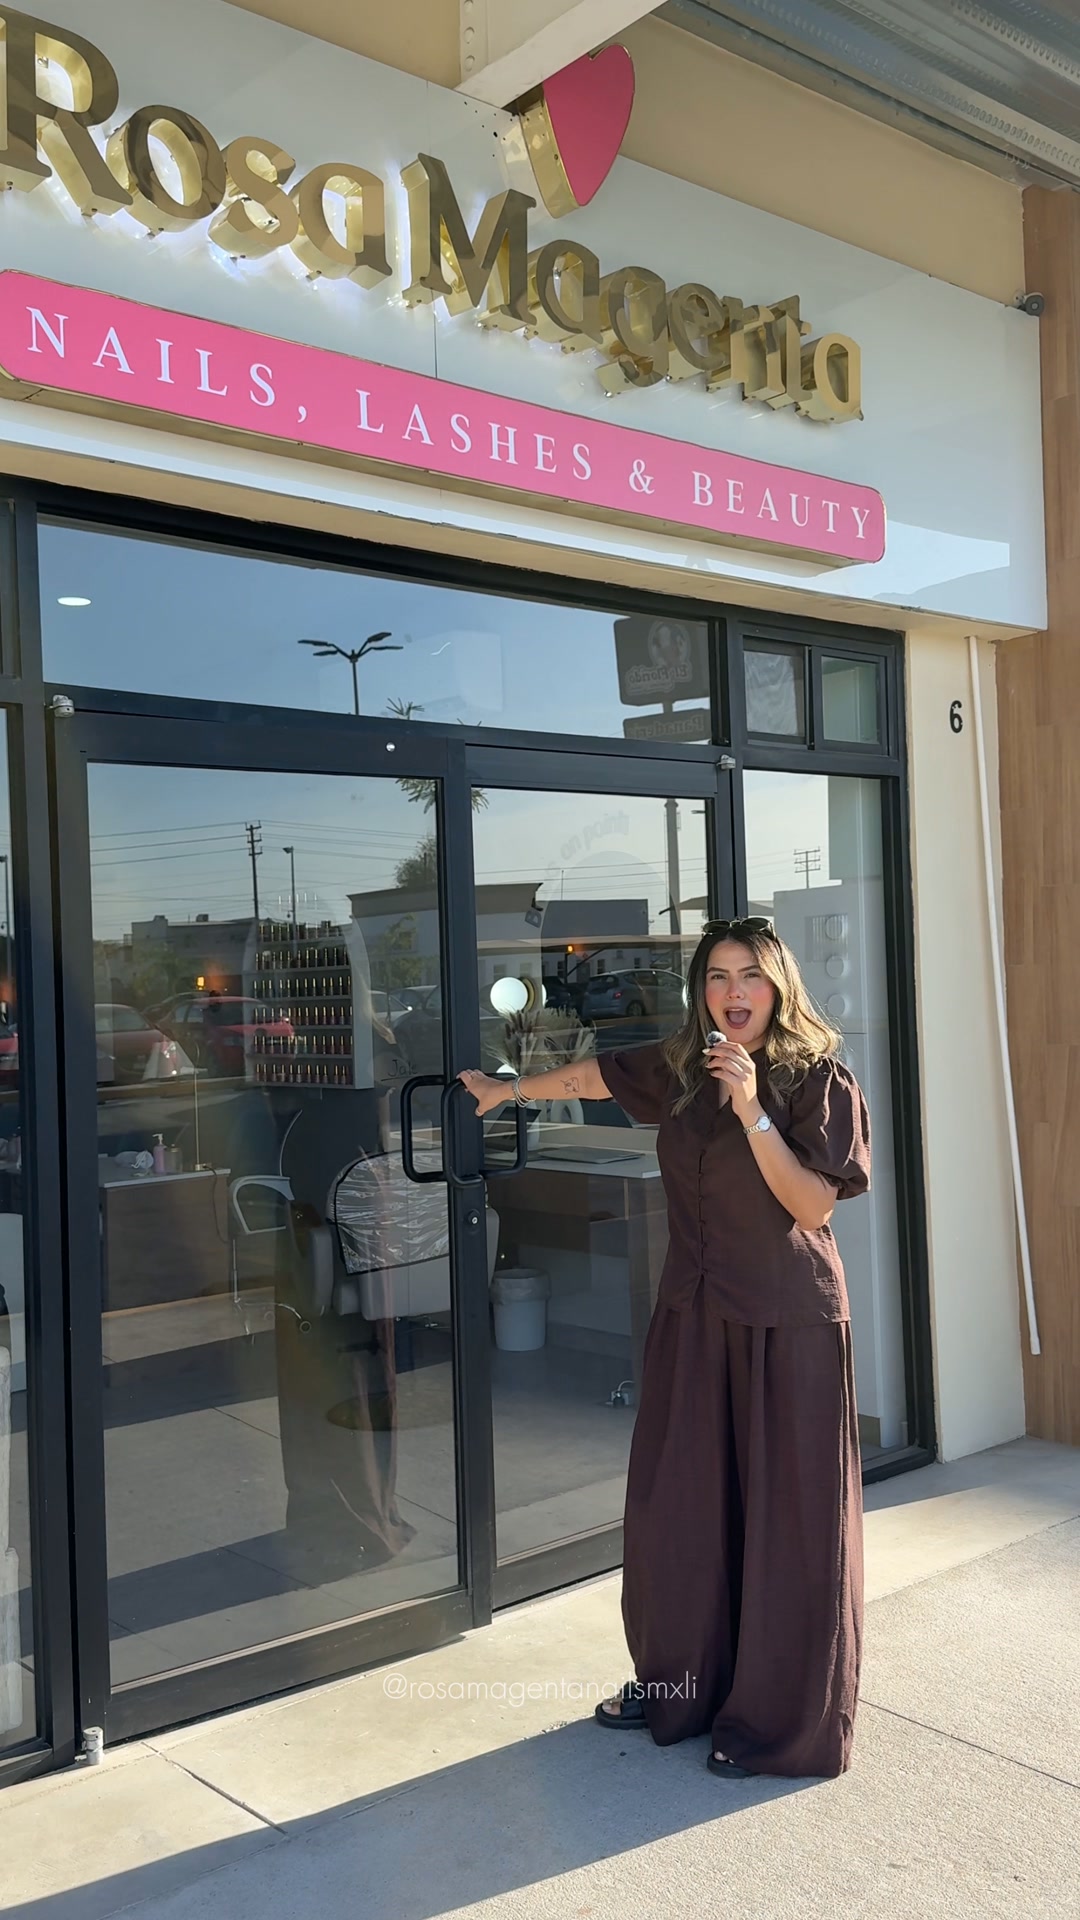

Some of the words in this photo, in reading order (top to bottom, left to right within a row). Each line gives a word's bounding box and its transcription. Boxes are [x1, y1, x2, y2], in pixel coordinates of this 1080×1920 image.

[0, 8, 392, 284] Rosa
[403, 152, 864, 422] Magenta
[26, 305, 309, 424] NAILS,
[356, 388, 593, 481] LASHES
[628, 457, 656, 496] &
[691, 470, 871, 540] BEAUTY
[950, 700, 963, 734] 6
